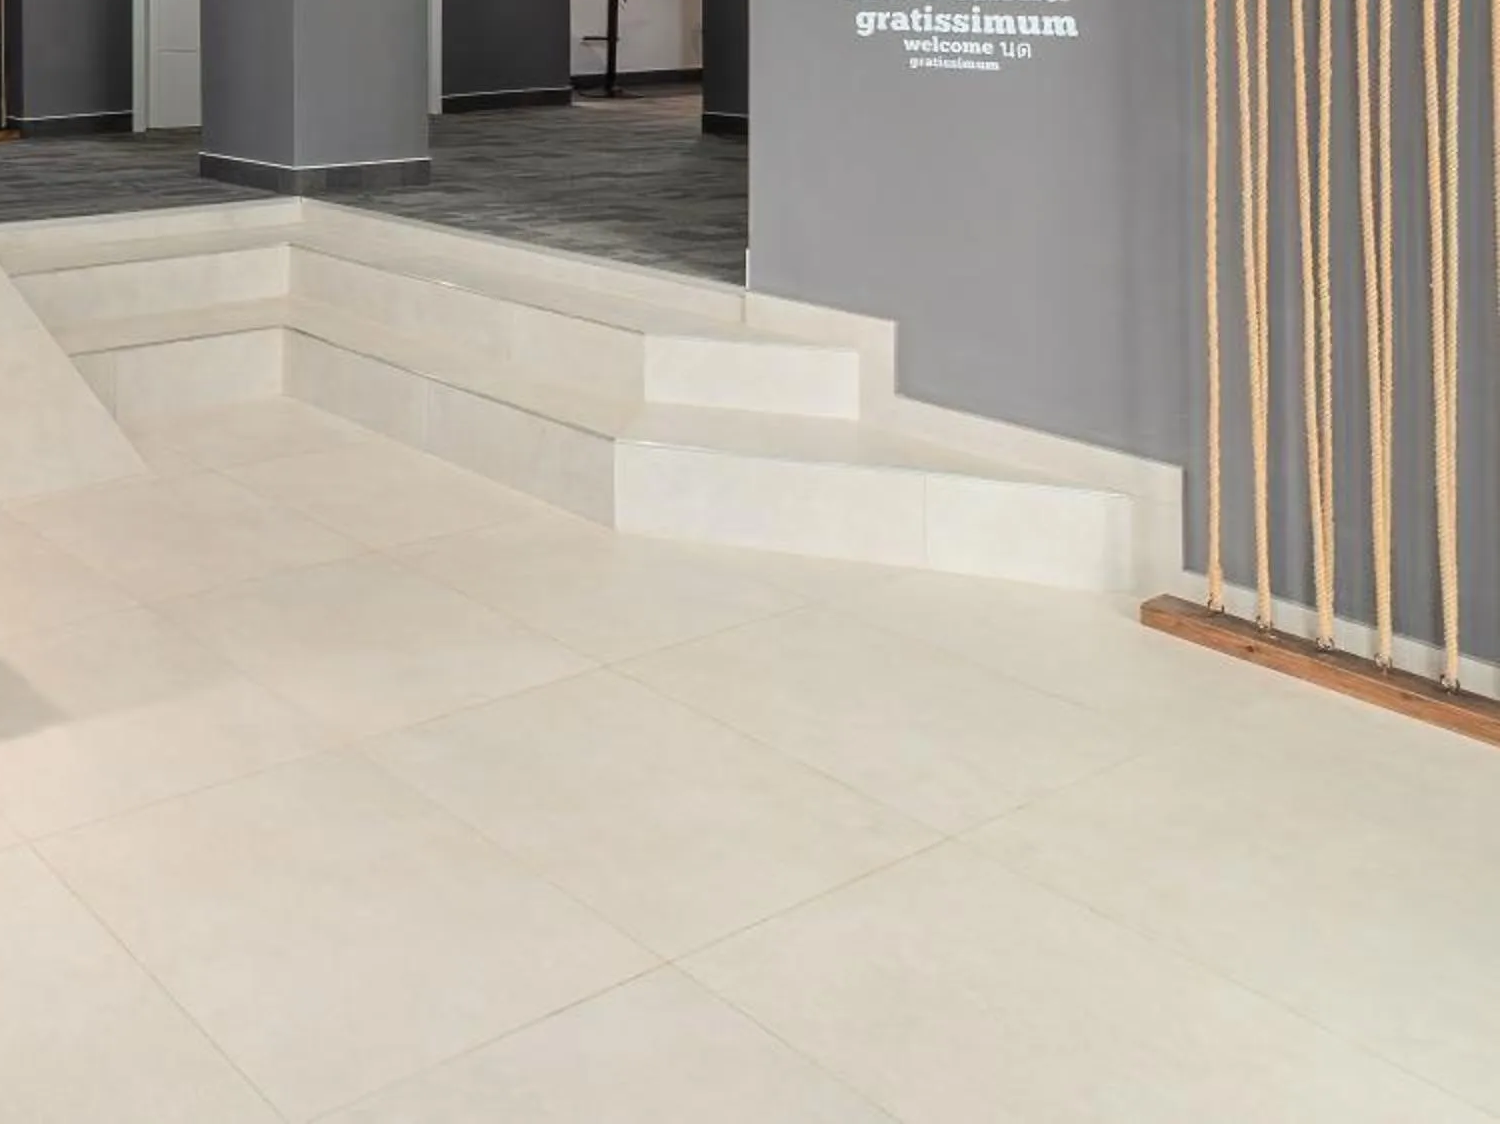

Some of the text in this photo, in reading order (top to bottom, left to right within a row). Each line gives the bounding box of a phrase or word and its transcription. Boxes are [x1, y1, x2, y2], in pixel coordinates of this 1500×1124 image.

[856, 5, 1078, 37] gratissimum
[903, 36, 993, 55] welcome
[910, 57, 999, 71] gratissimum
